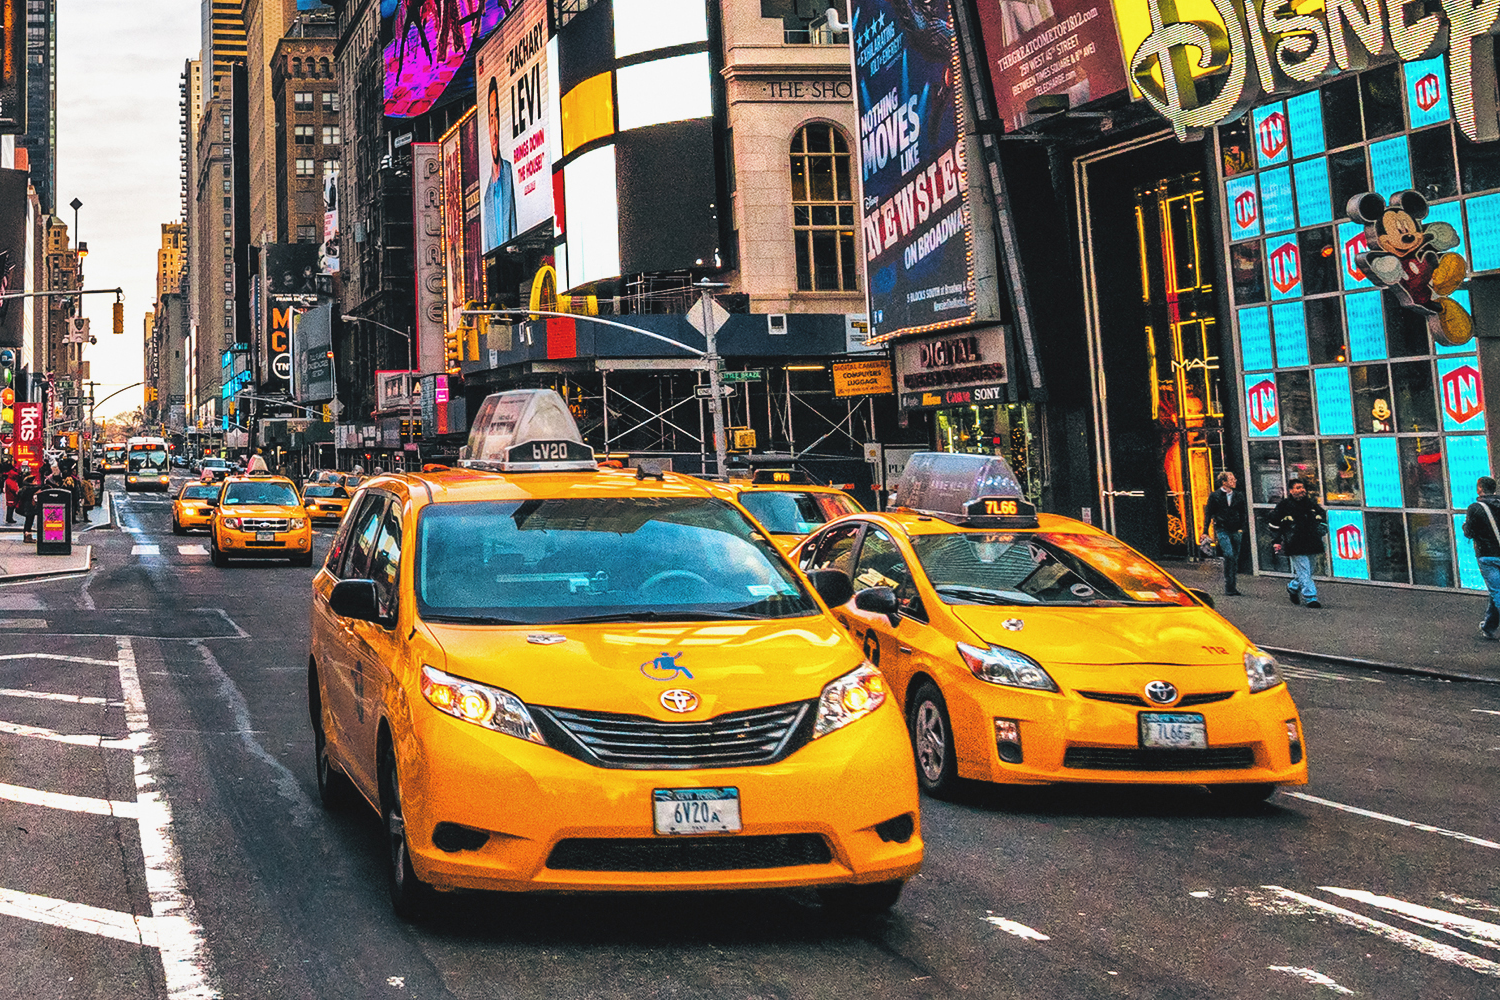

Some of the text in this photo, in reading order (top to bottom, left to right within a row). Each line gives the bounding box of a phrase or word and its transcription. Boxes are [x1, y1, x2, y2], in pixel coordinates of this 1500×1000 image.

[506, 19, 544, 78] "ZACHARY
[1028, 34, 1079, 70] WEST STREET
[1035, 57, 1071, 83] TIMES SQUARE
[511, 61, 542, 140] LEVI
[768, 81, 807, 98] THE
[860, 87, 898, 137] NOTHING
[513, 128, 545, 165] BRINGS DOWN
[862, 94, 920, 181] MOVES
[518, 166, 526, 184] THE
[901, 141, 920, 177] LIKE
[863, 139, 967, 262] NEWSIES
[423, 158, 445, 323] PALACE
[904, 241, 918, 270] ON
[920, 338, 978, 368] DIGITAL
[843, 371, 881, 379] COMPUTERS
[847, 378, 878, 386] LUGGAGE
[974, 387, 1000, 400] SONY
[21, 407, 38, 441] tkts
[533, 443, 567, 460] 6V20
[985, 500, 1017, 515] 7L66
